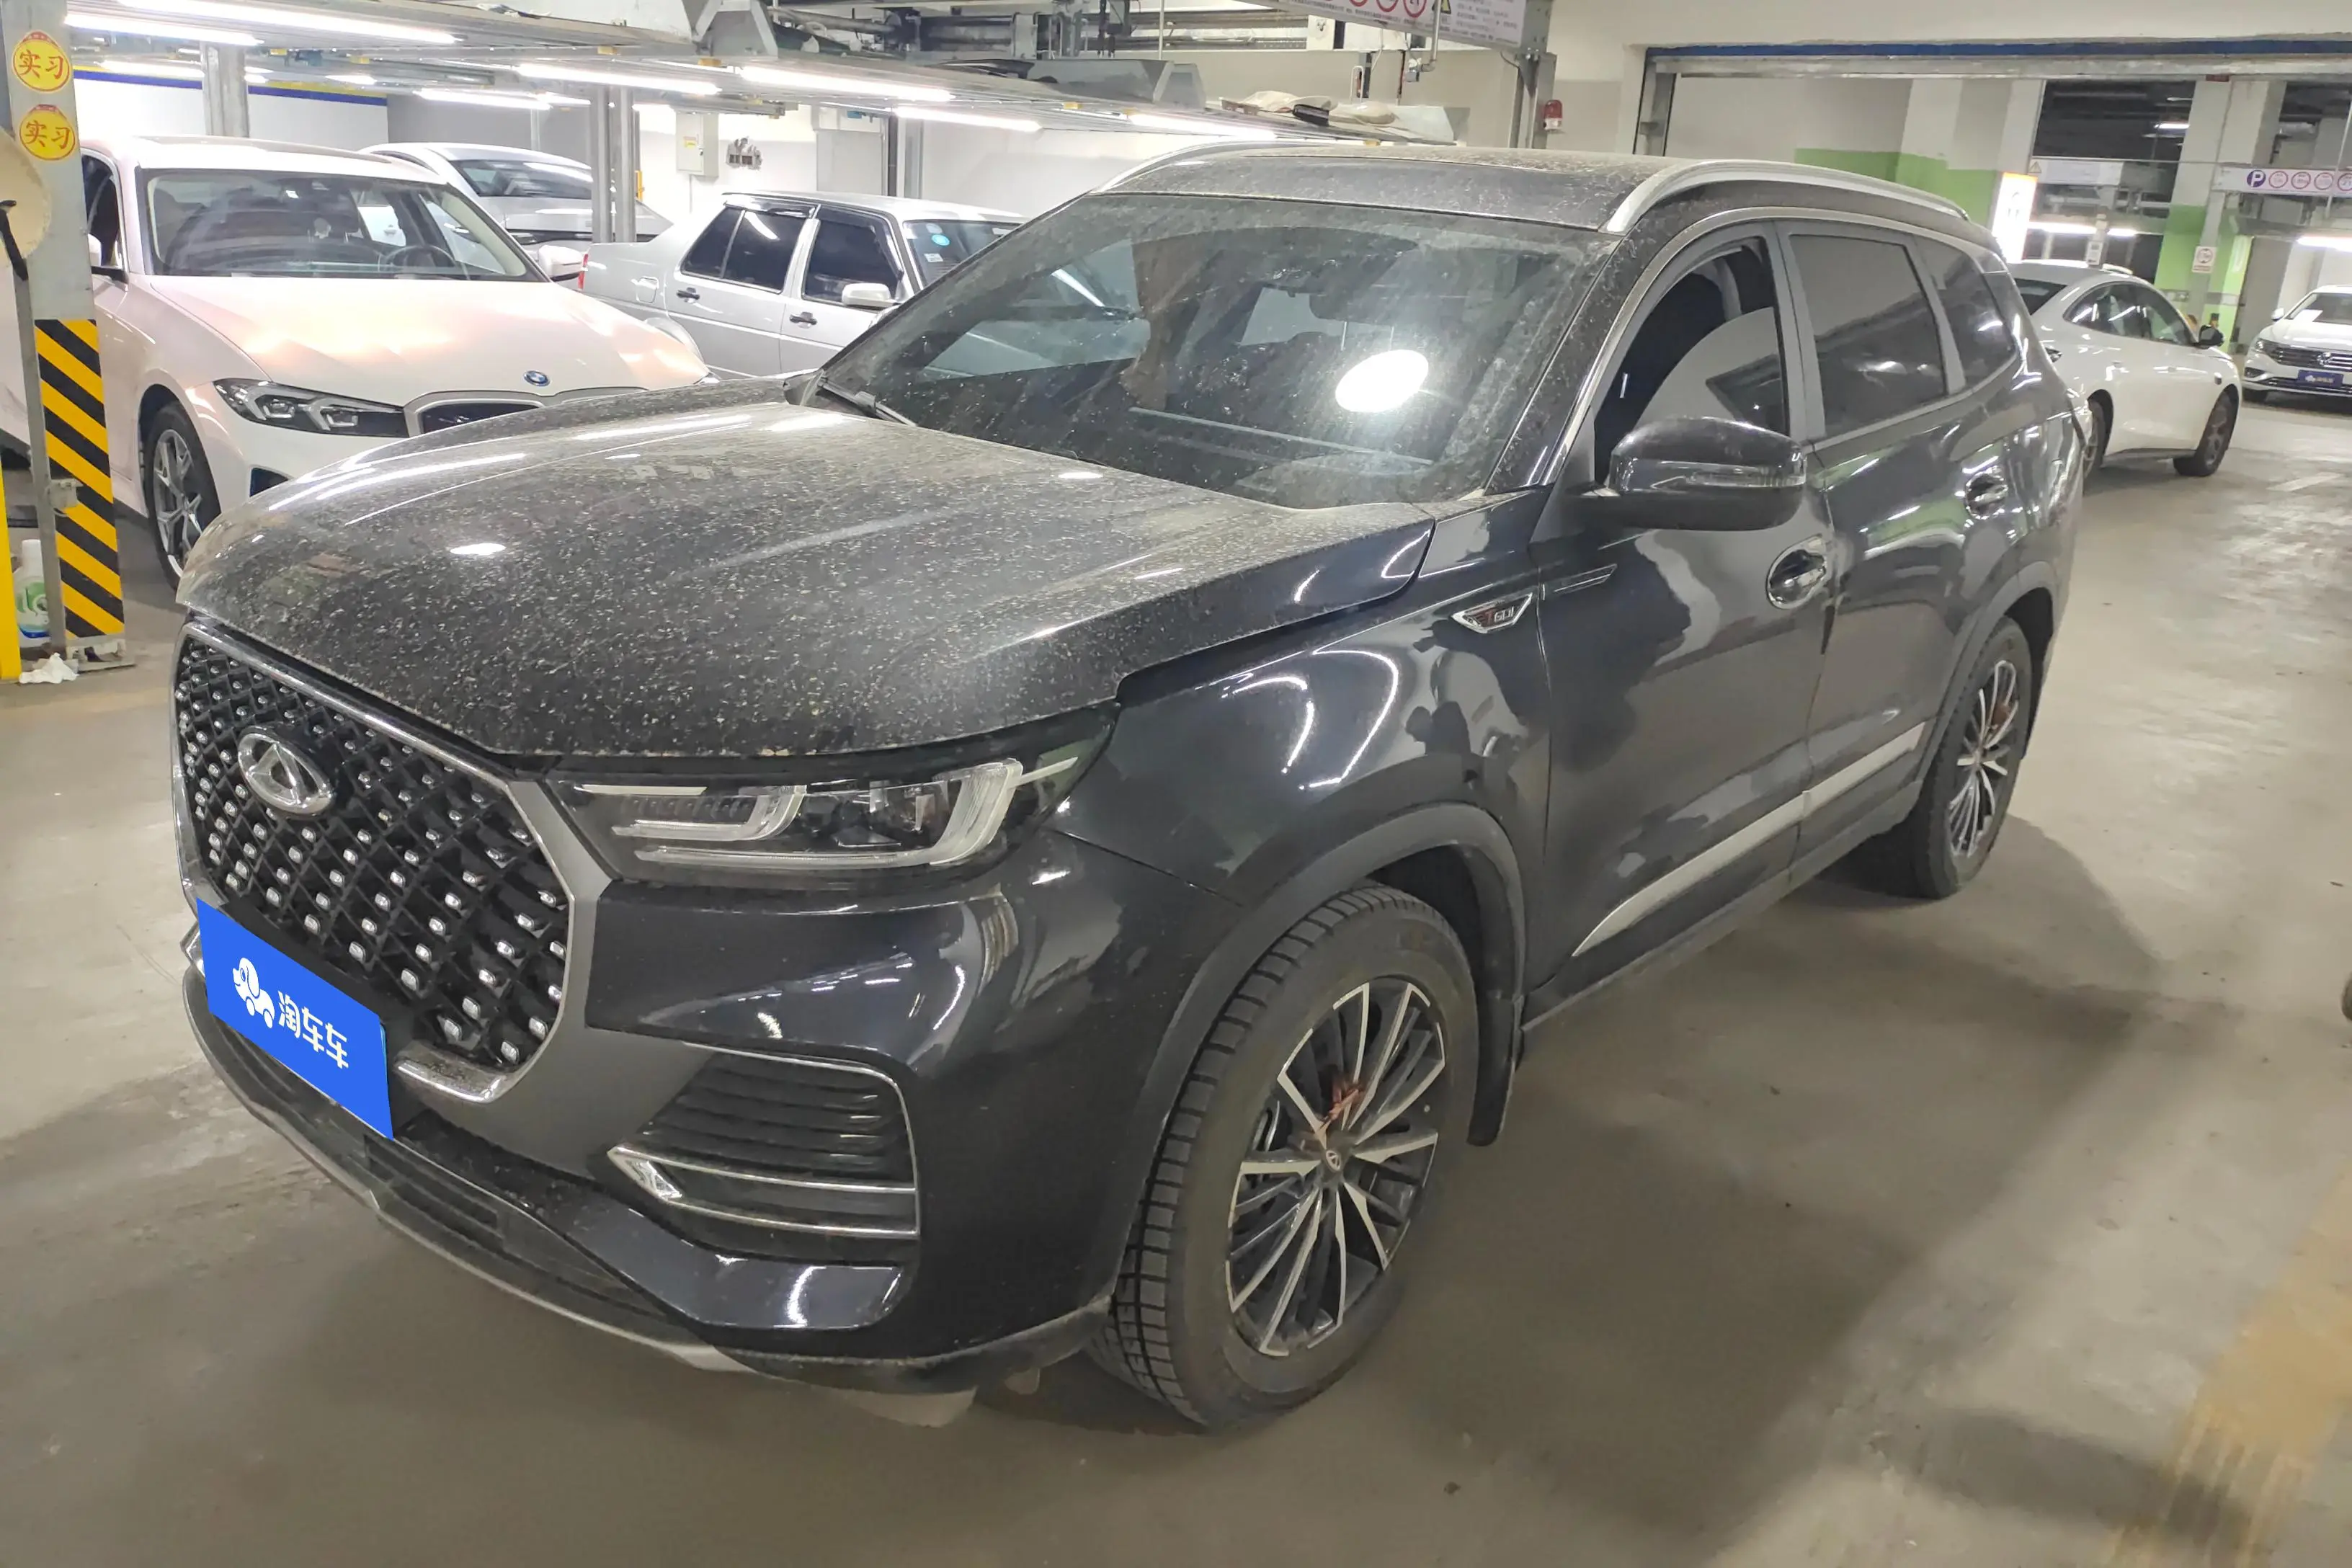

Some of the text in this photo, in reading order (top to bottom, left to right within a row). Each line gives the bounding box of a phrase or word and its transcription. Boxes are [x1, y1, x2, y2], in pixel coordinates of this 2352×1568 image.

[19, 49, 64, 80] 实习
[25, 120, 71, 151] 实习
[2250, 171, 2265, 187] P
